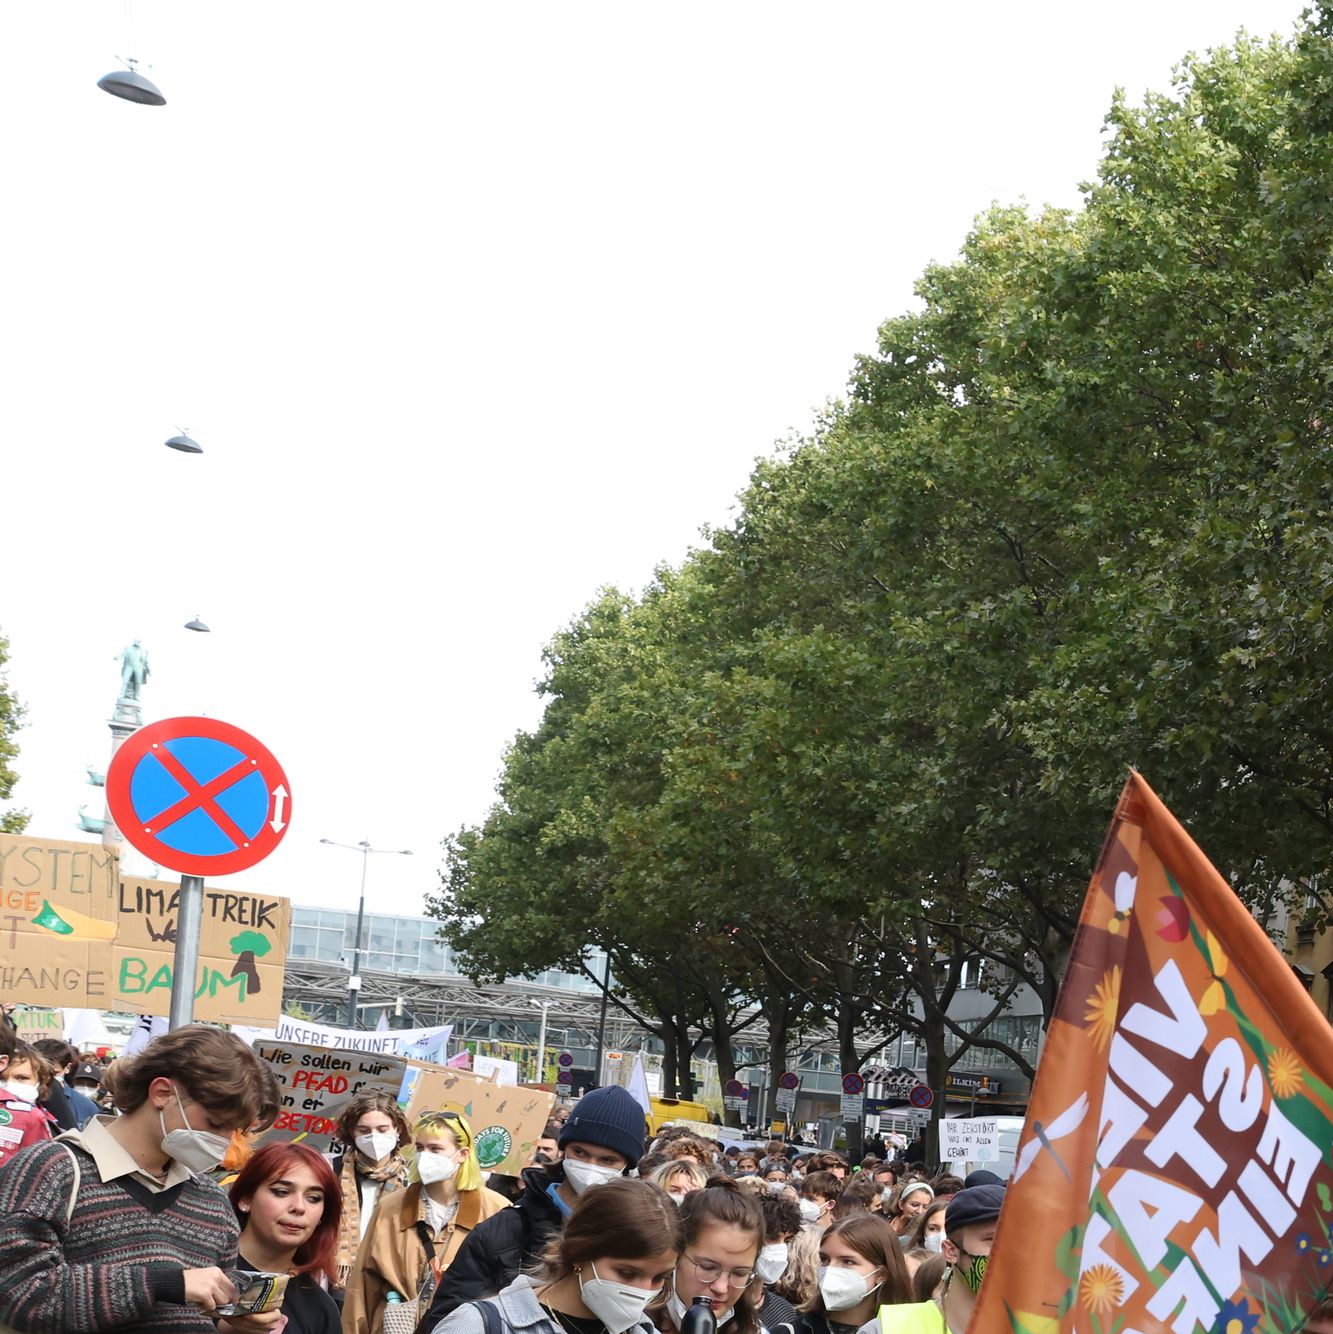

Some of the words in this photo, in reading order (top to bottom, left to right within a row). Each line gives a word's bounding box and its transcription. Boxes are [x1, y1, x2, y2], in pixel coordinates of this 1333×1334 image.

[0, 845, 114, 898] YSTEM
[119, 883, 279, 929] LIMATREIK
[0, 967, 105, 996] HANGE
[260, 1047, 292, 1065] Wie
[300, 1053, 351, 1071] sollen
[359, 1062, 390, 1076] wir
[291, 1070, 349, 1094] PFAD
[302, 1098, 324, 1111] er
